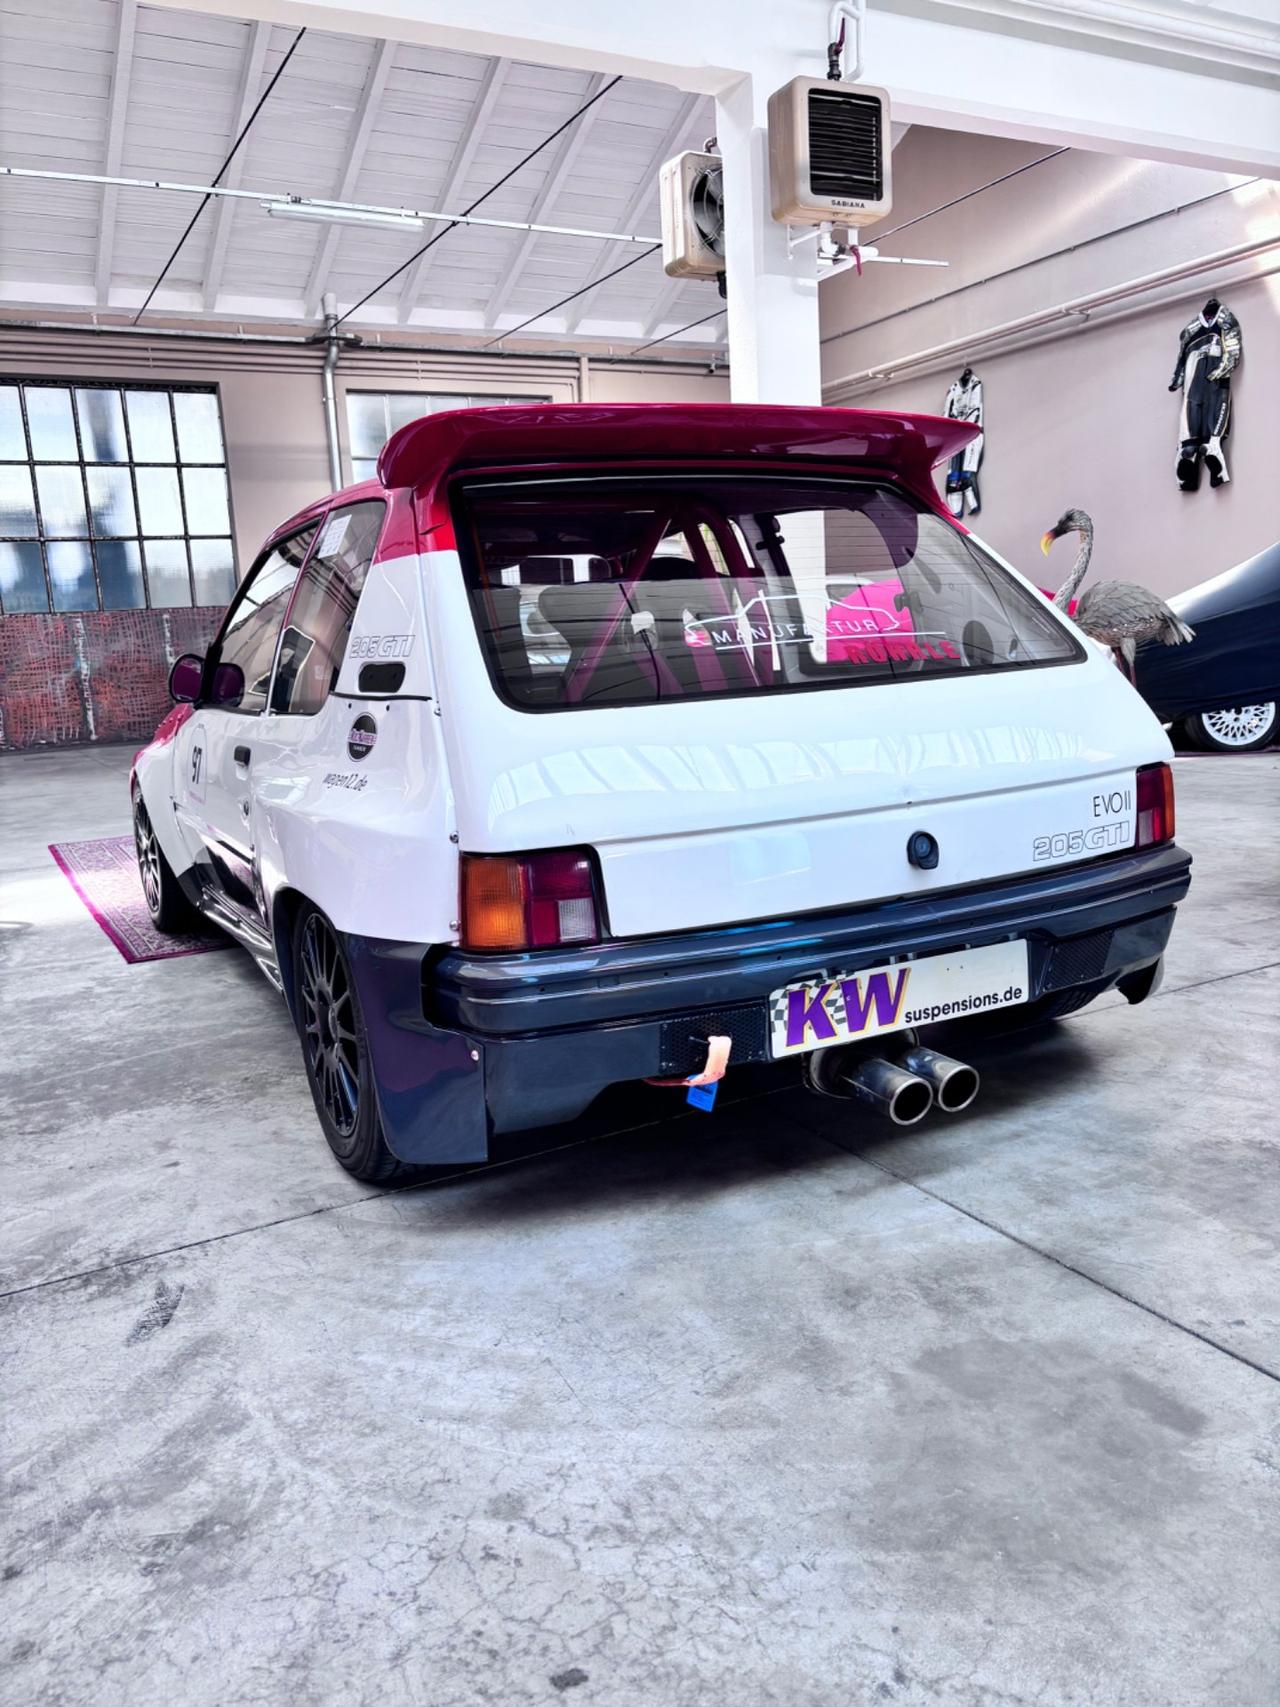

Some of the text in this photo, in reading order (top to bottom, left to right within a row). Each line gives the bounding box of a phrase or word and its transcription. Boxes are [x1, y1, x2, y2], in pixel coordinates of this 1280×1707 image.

[831, 199, 865, 209] SABIANA
[349, 634, 416, 659] 205GTI
[1033, 820, 1131, 862] 205GTI
[786, 967, 911, 1048] KW
[904, 985, 1023, 1024] suspensions.de
